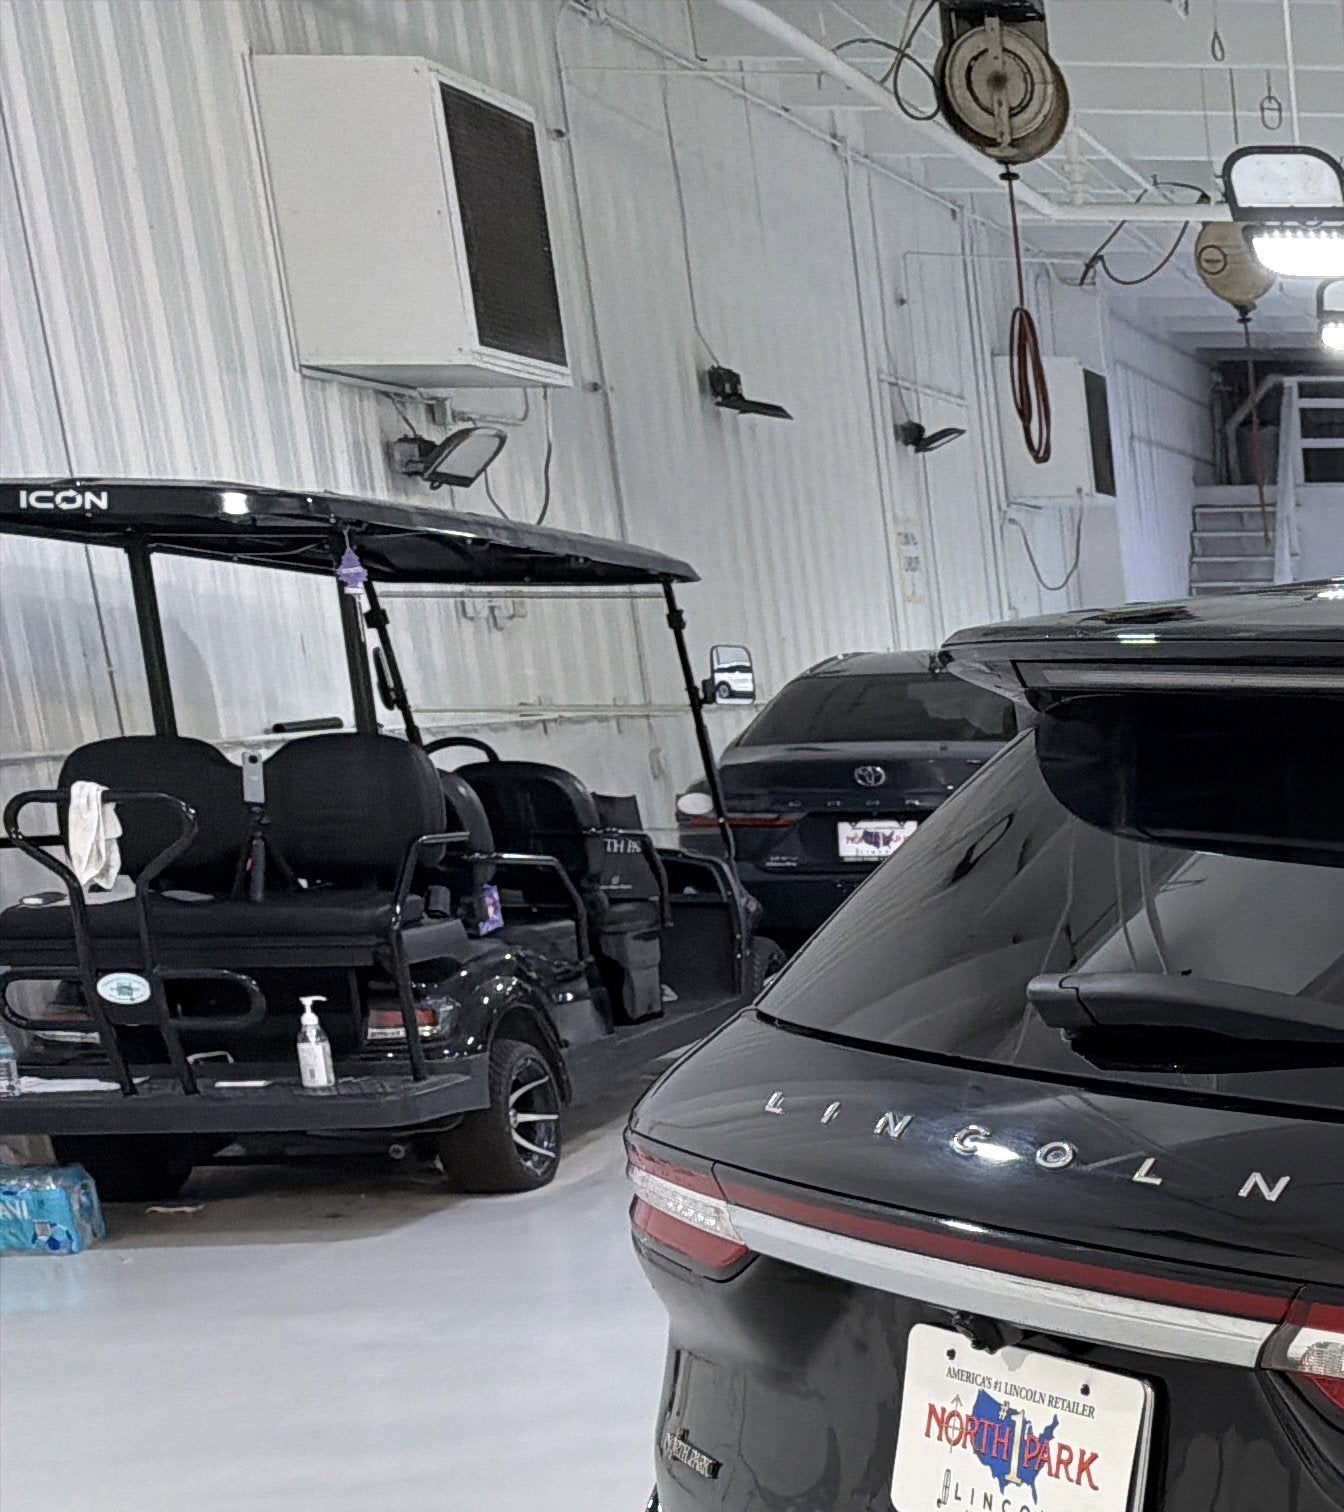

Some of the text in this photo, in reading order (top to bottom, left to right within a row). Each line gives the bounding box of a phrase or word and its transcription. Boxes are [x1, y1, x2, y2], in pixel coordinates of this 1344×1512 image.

[20, 488, 108, 511] ICON
[764, 1090, 1291, 1202] LINCOLN
[946, 1366, 992, 1391] AMERICA'S
[1003, 1381, 1047, 1406] LINCOLN
[1047, 1393, 1096, 1420] RETAILER
[924, 1402, 1100, 1491] NORTH PARK
